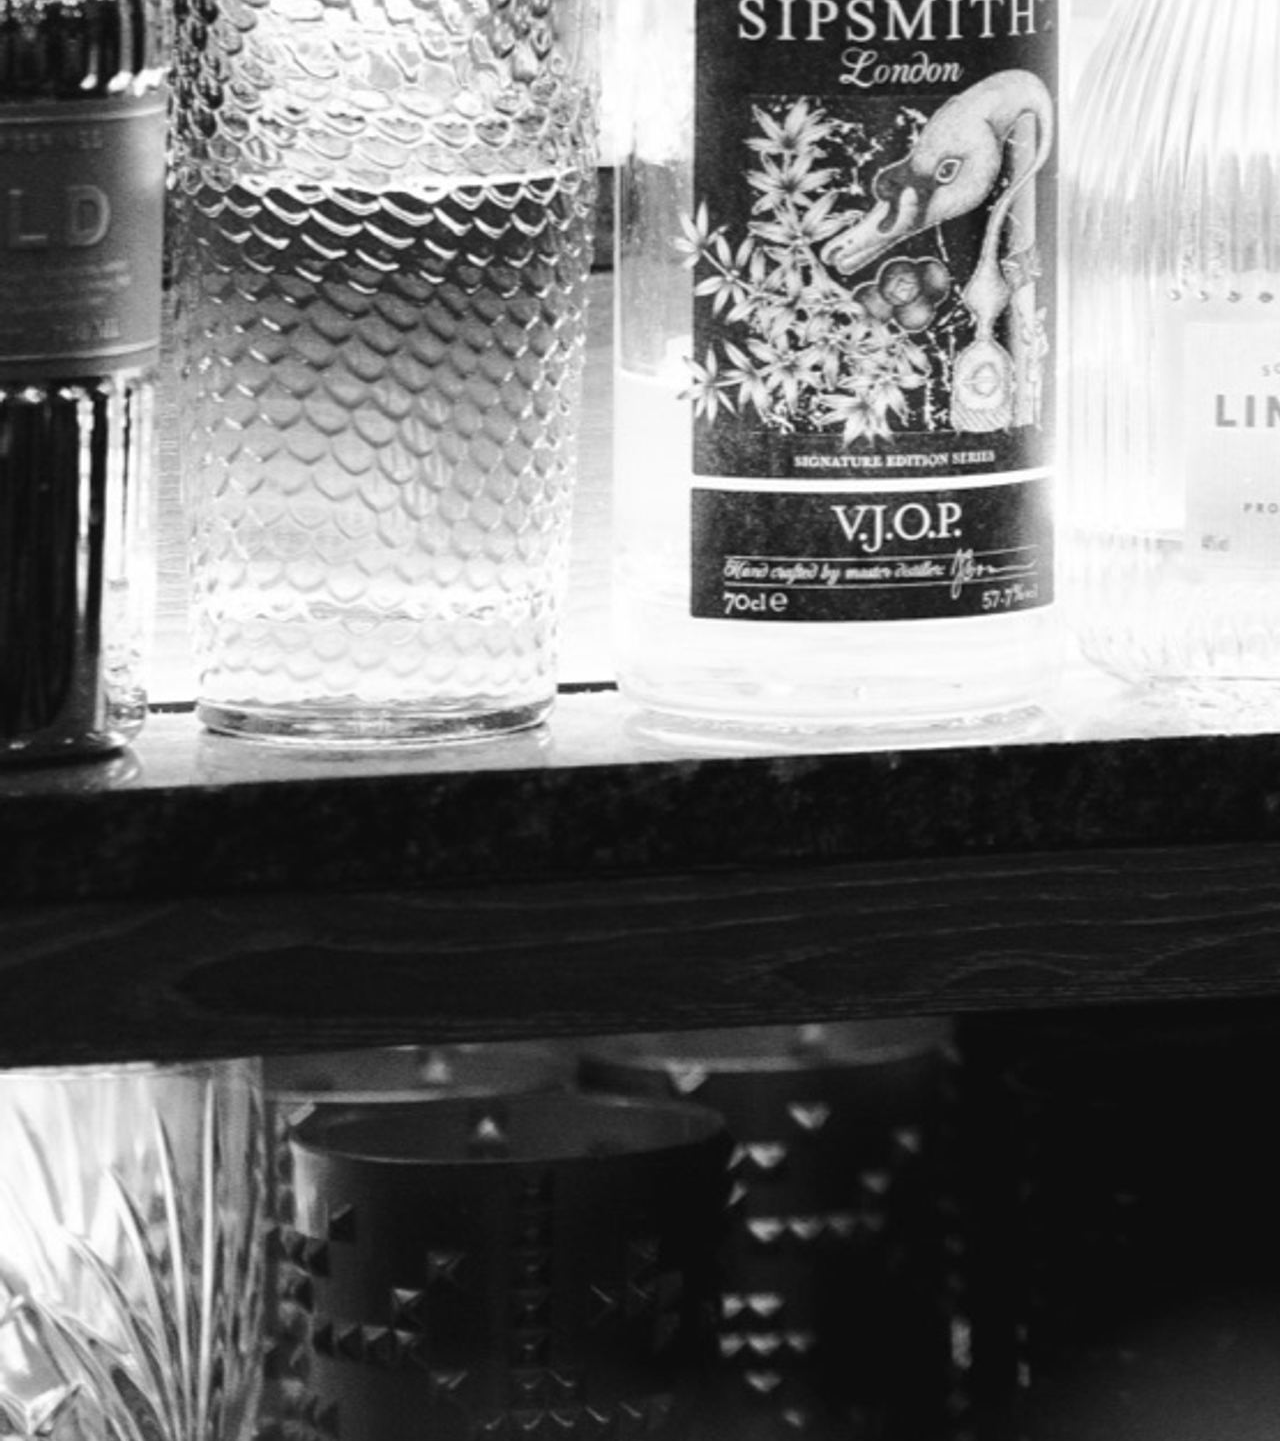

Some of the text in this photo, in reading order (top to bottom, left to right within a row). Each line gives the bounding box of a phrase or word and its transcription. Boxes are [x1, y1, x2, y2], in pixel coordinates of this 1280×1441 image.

[838, 48, 964, 92] London
[794, 450, 995, 468] SIGNATURE EDITION SERIES
[830, 502, 964, 553] V.J.O.P.
[723, 559, 769, 579] Hand
[771, 560, 818, 584] crafted
[820, 563, 841, 586] by
[722, 591, 766, 614] 70cl
